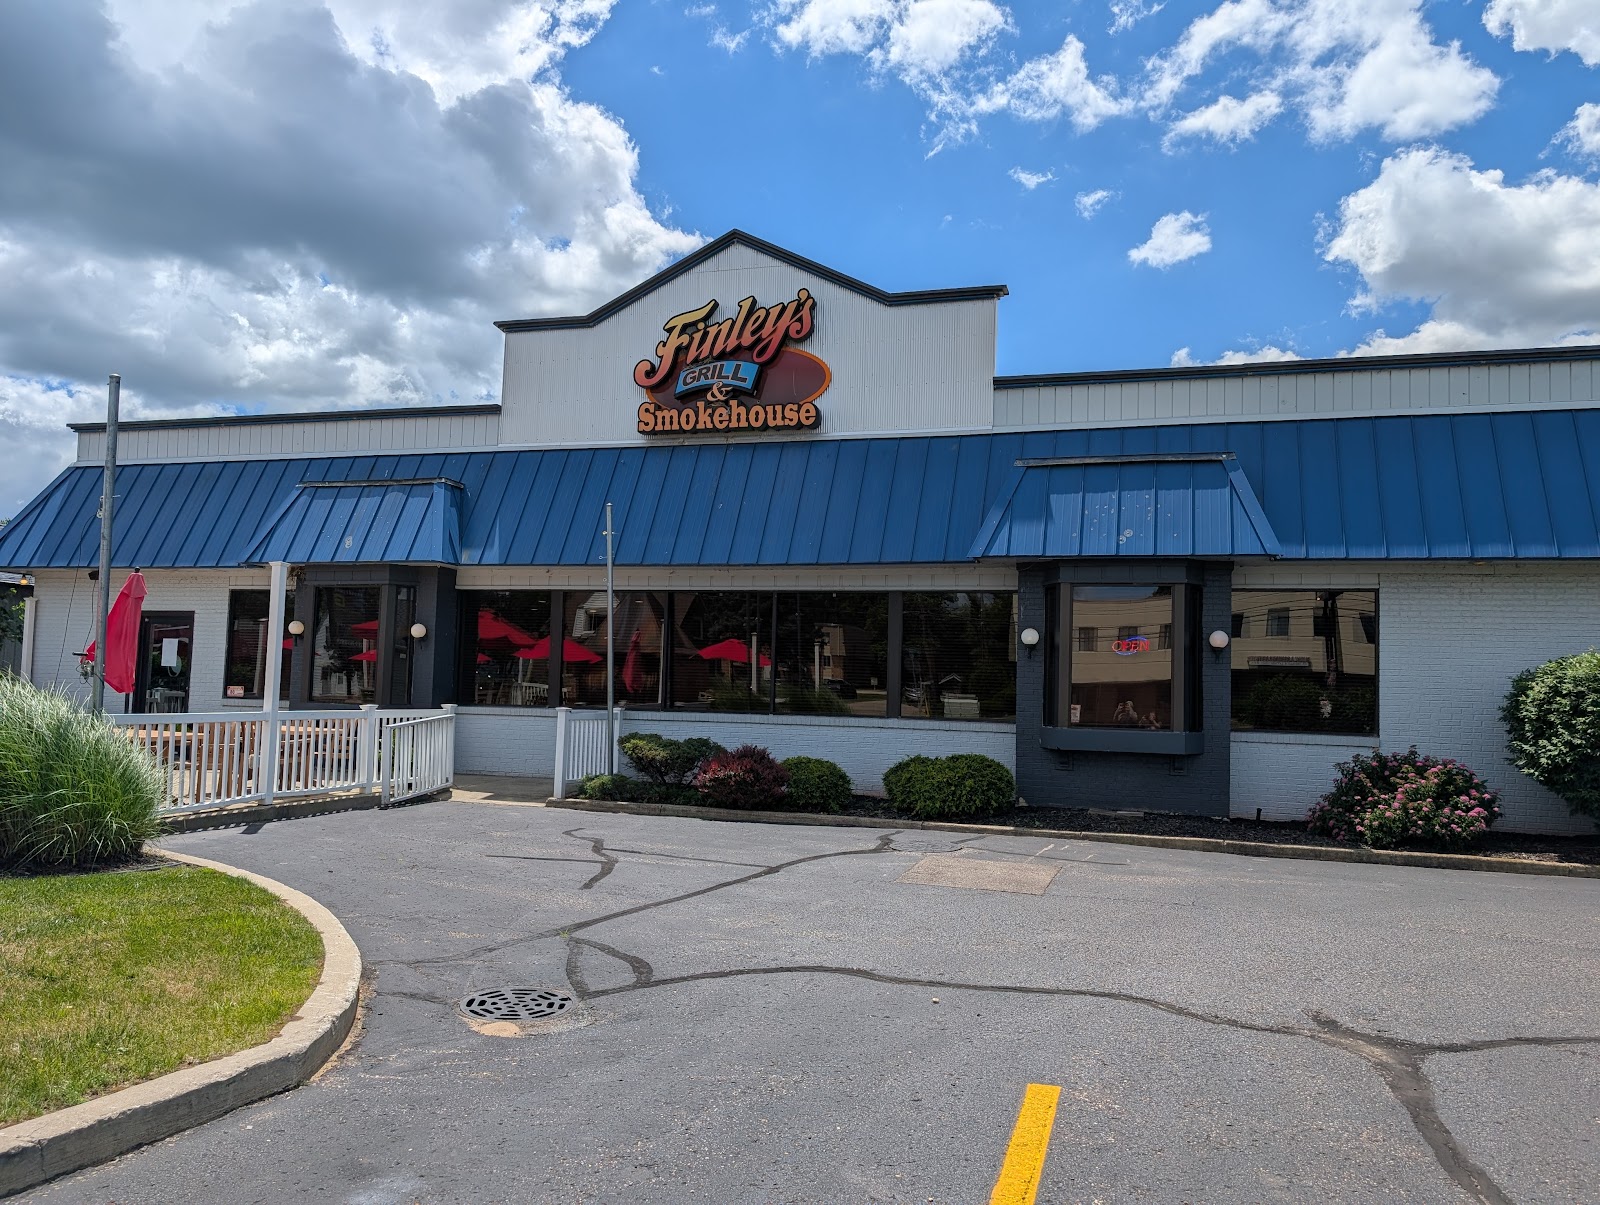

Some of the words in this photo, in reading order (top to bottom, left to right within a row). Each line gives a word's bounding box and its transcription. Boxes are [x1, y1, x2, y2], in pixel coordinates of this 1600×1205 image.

[634, 289, 815, 387] Finley's
[682, 364, 749, 387] GRILL
[706, 382, 733, 402] &
[638, 400, 817, 432] Smokehouse
[1111, 640, 1150, 652] OPEN
